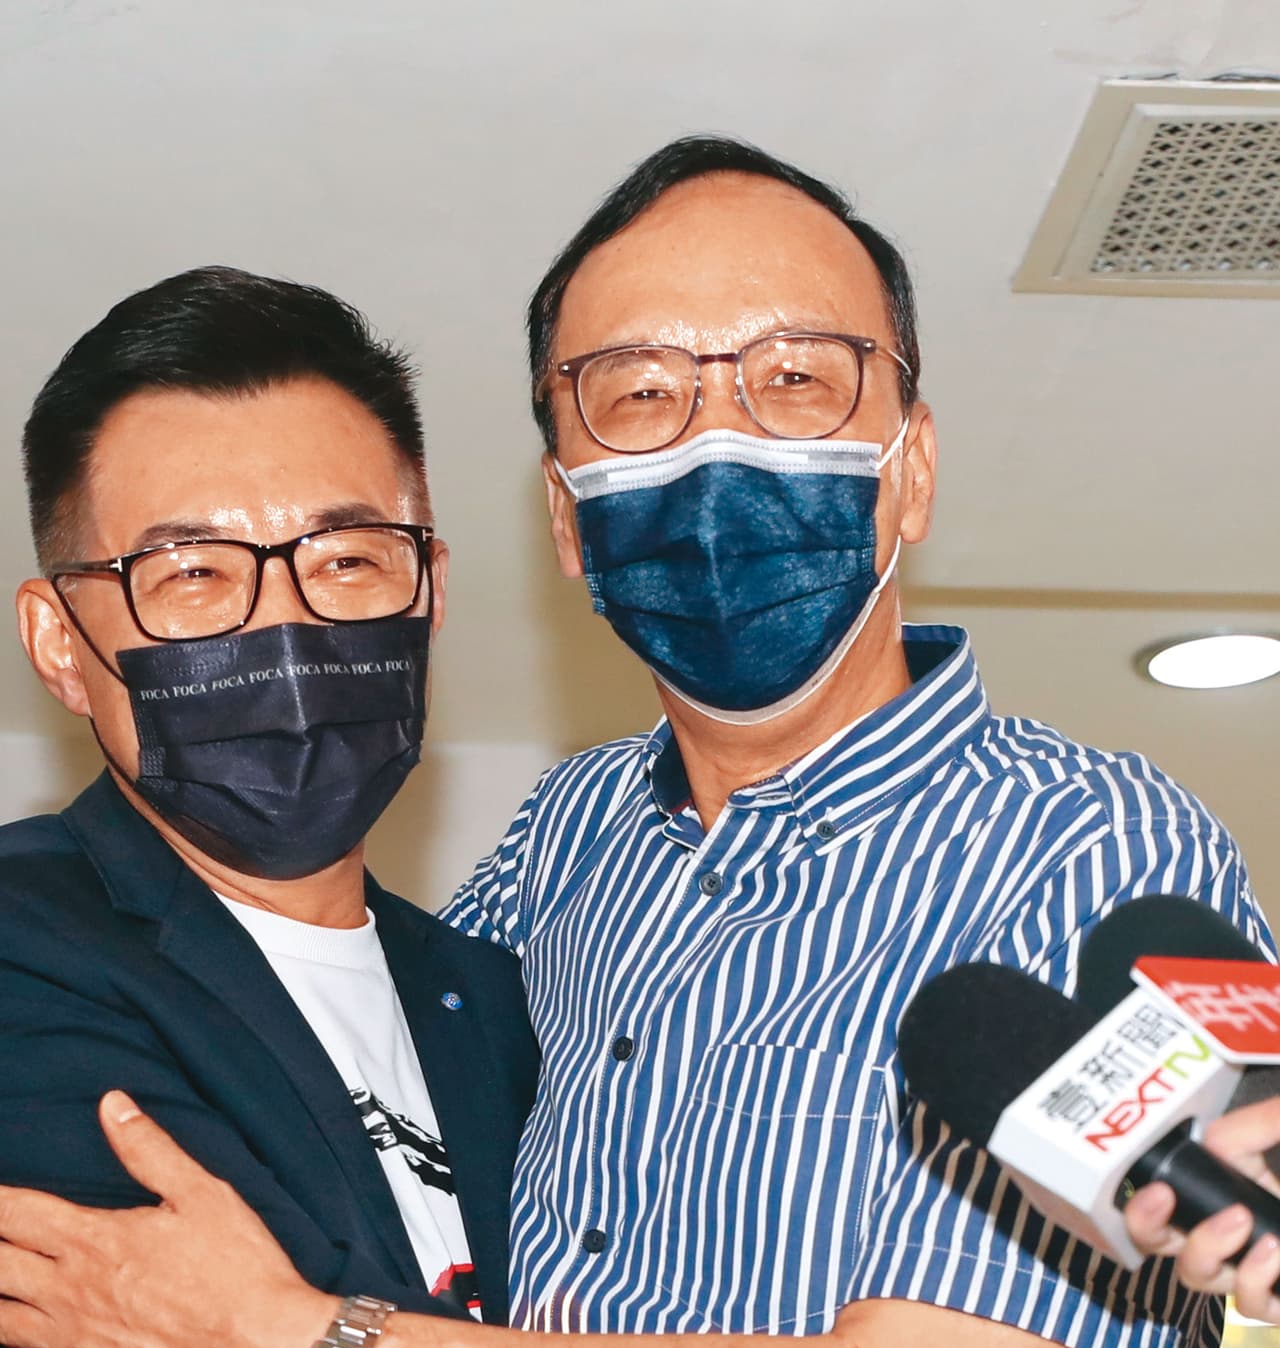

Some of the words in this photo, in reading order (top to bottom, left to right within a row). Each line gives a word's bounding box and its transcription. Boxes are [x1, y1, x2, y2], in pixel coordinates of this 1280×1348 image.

[140, 688, 169, 701] FOCA
[172, 683, 207, 697] FOCA
[212, 675, 245, 691] FOCA
[249, 668, 283, 683] FOCA
[289, 663, 321, 676] FOCA
[324, 663, 350, 675] FOCA
[352, 662, 382, 675] FOCA
[385, 660, 410, 672] FOCA
